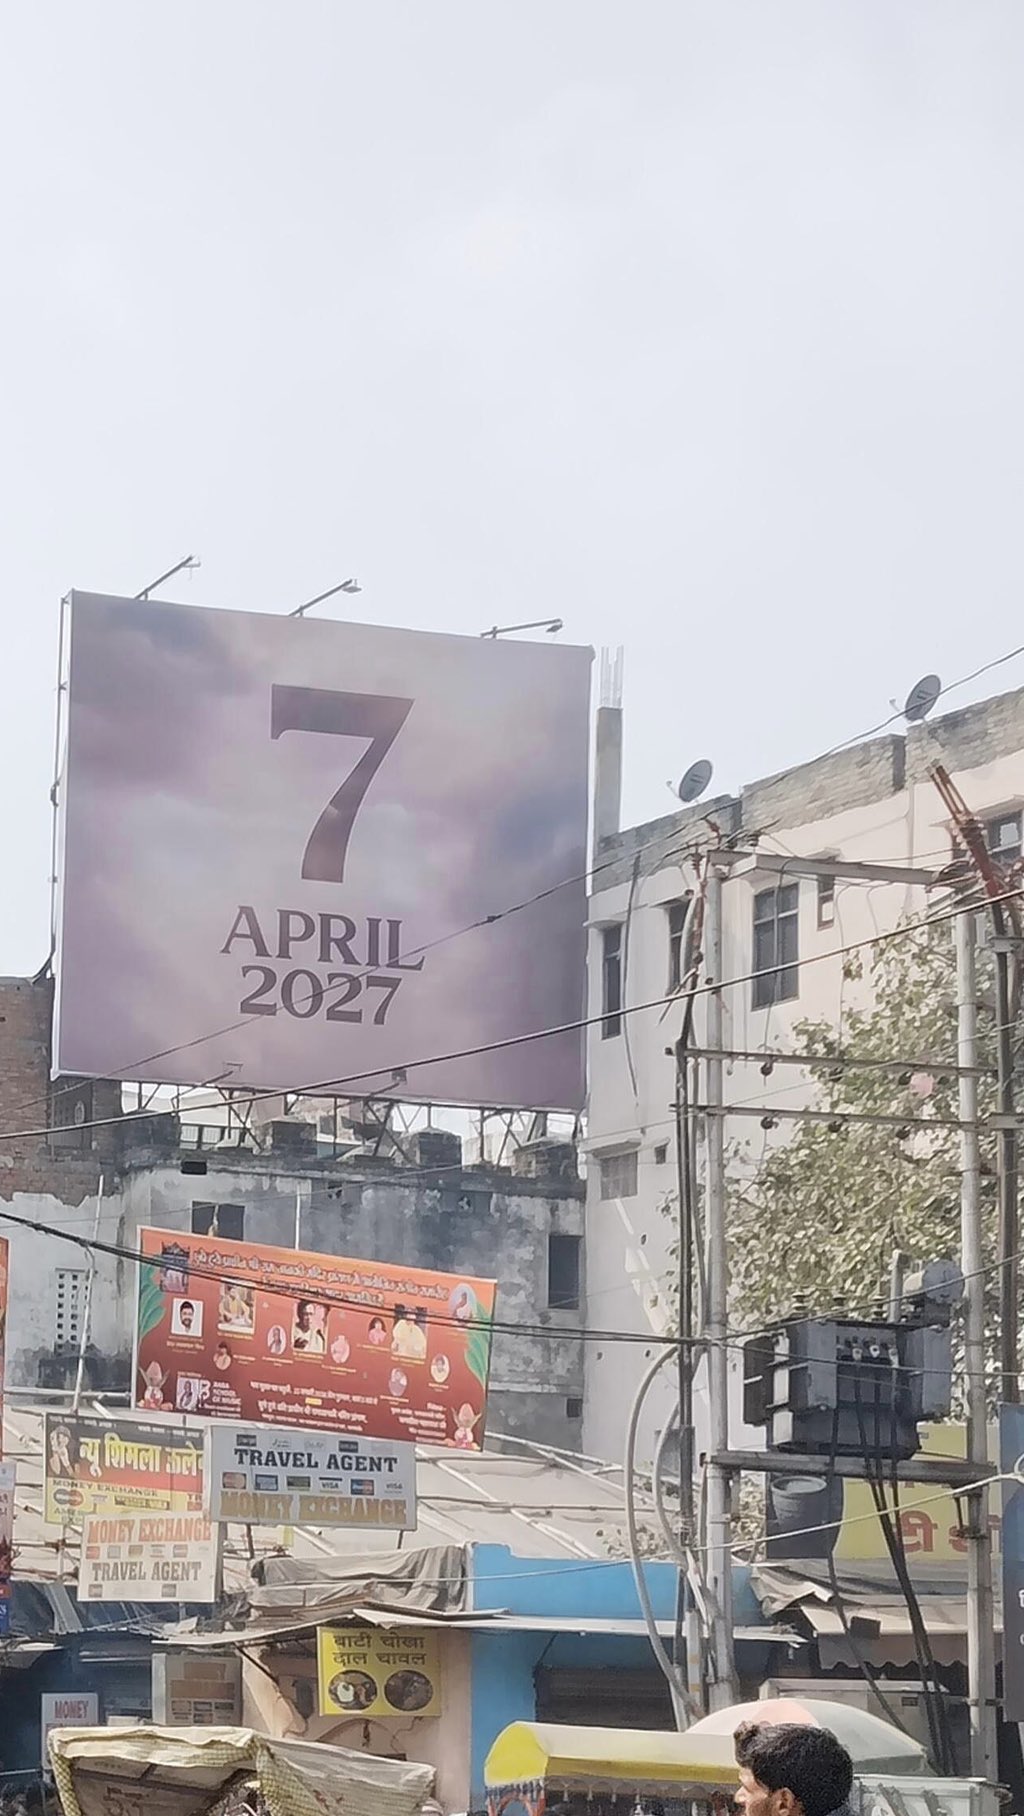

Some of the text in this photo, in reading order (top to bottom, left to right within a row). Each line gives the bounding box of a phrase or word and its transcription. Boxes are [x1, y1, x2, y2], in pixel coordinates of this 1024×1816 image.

[270, 683, 416, 884] 7
[219, 905, 426, 972] APRIL
[239, 965, 403, 1026] 2027
[233, 1447, 398, 1473] TRAVEL AGENT
[52, 1479, 93, 1490] MONEY
[87, 1516, 212, 1544] MONEY EXCHANGE
[91, 1560, 202, 1582] TRAVEL AGENT
[332, 1651, 427, 1667] दाल चावल
[54, 1700, 89, 1719] MONEY
